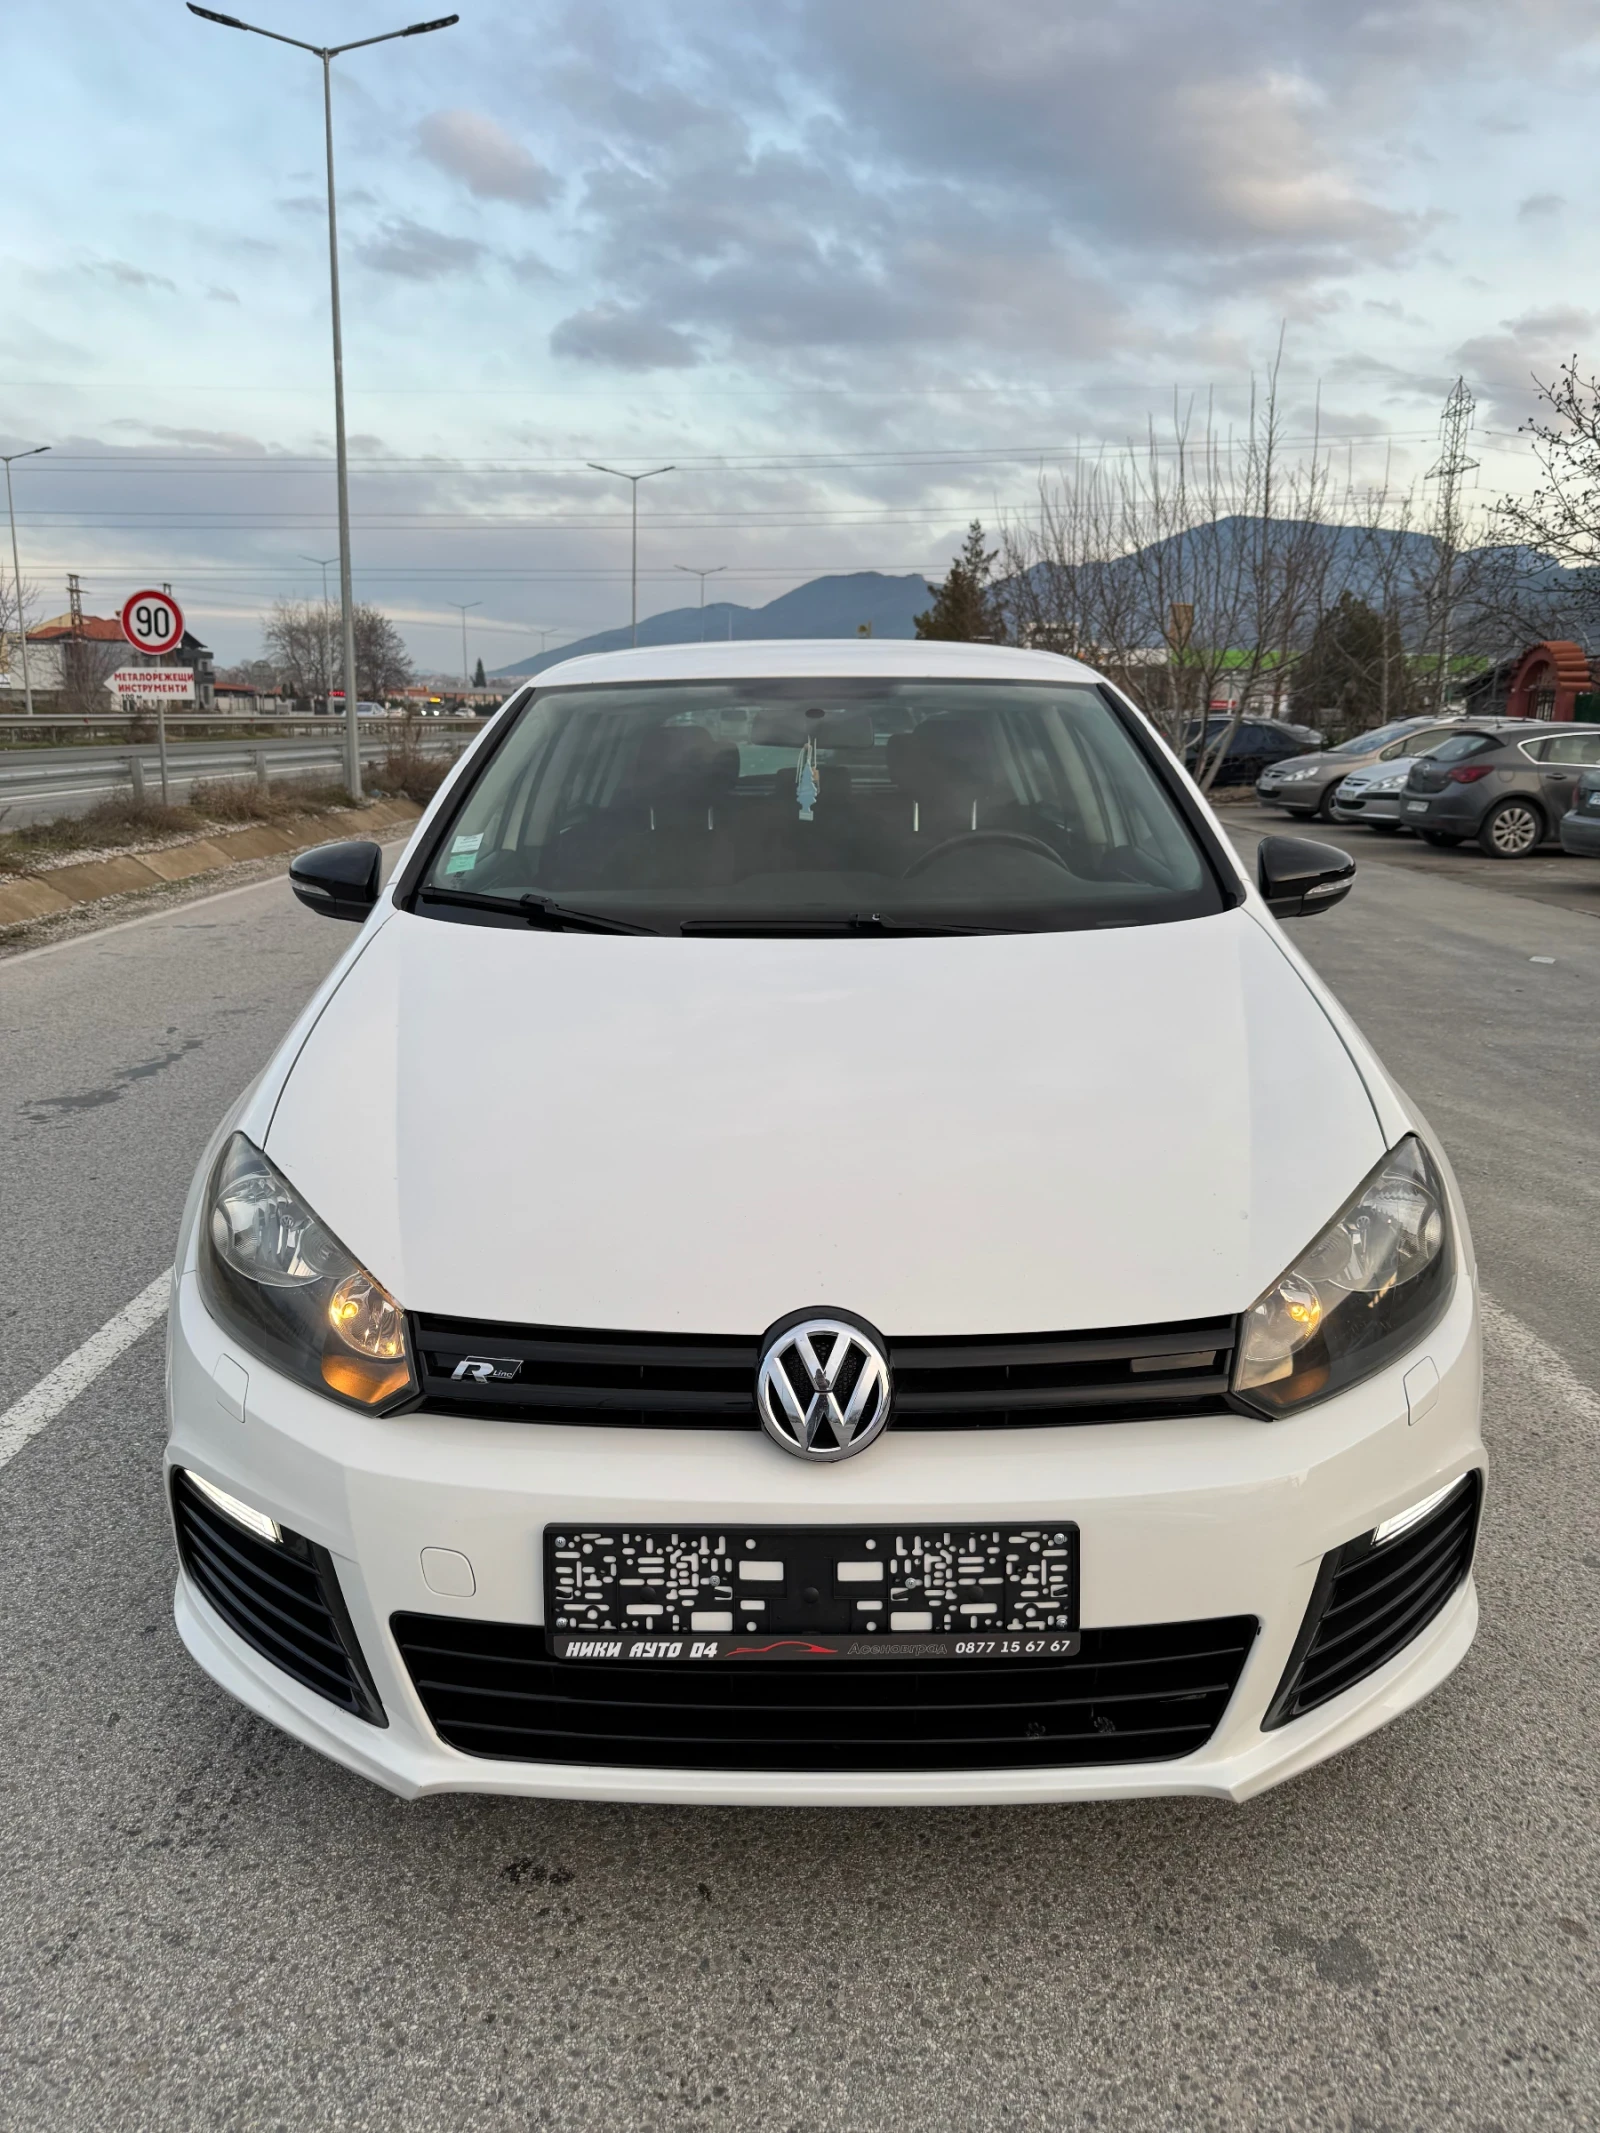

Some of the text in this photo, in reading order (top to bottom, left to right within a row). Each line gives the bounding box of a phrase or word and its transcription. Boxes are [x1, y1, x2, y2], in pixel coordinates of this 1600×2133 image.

[136, 606, 169, 638] 90
[114, 672, 194, 682] МЕТАЛОРЕЖЕЩИ
[118, 684, 187, 692] ИНСТРУМЕНТИ
[565, 1641, 623, 1658] НИКИ
[955, 1641, 996, 1654] 0877
[1000, 1641, 1021, 1653] 15
[1025, 1640, 1046, 1653] 67
[1050, 1640, 1071, 1652] 67
